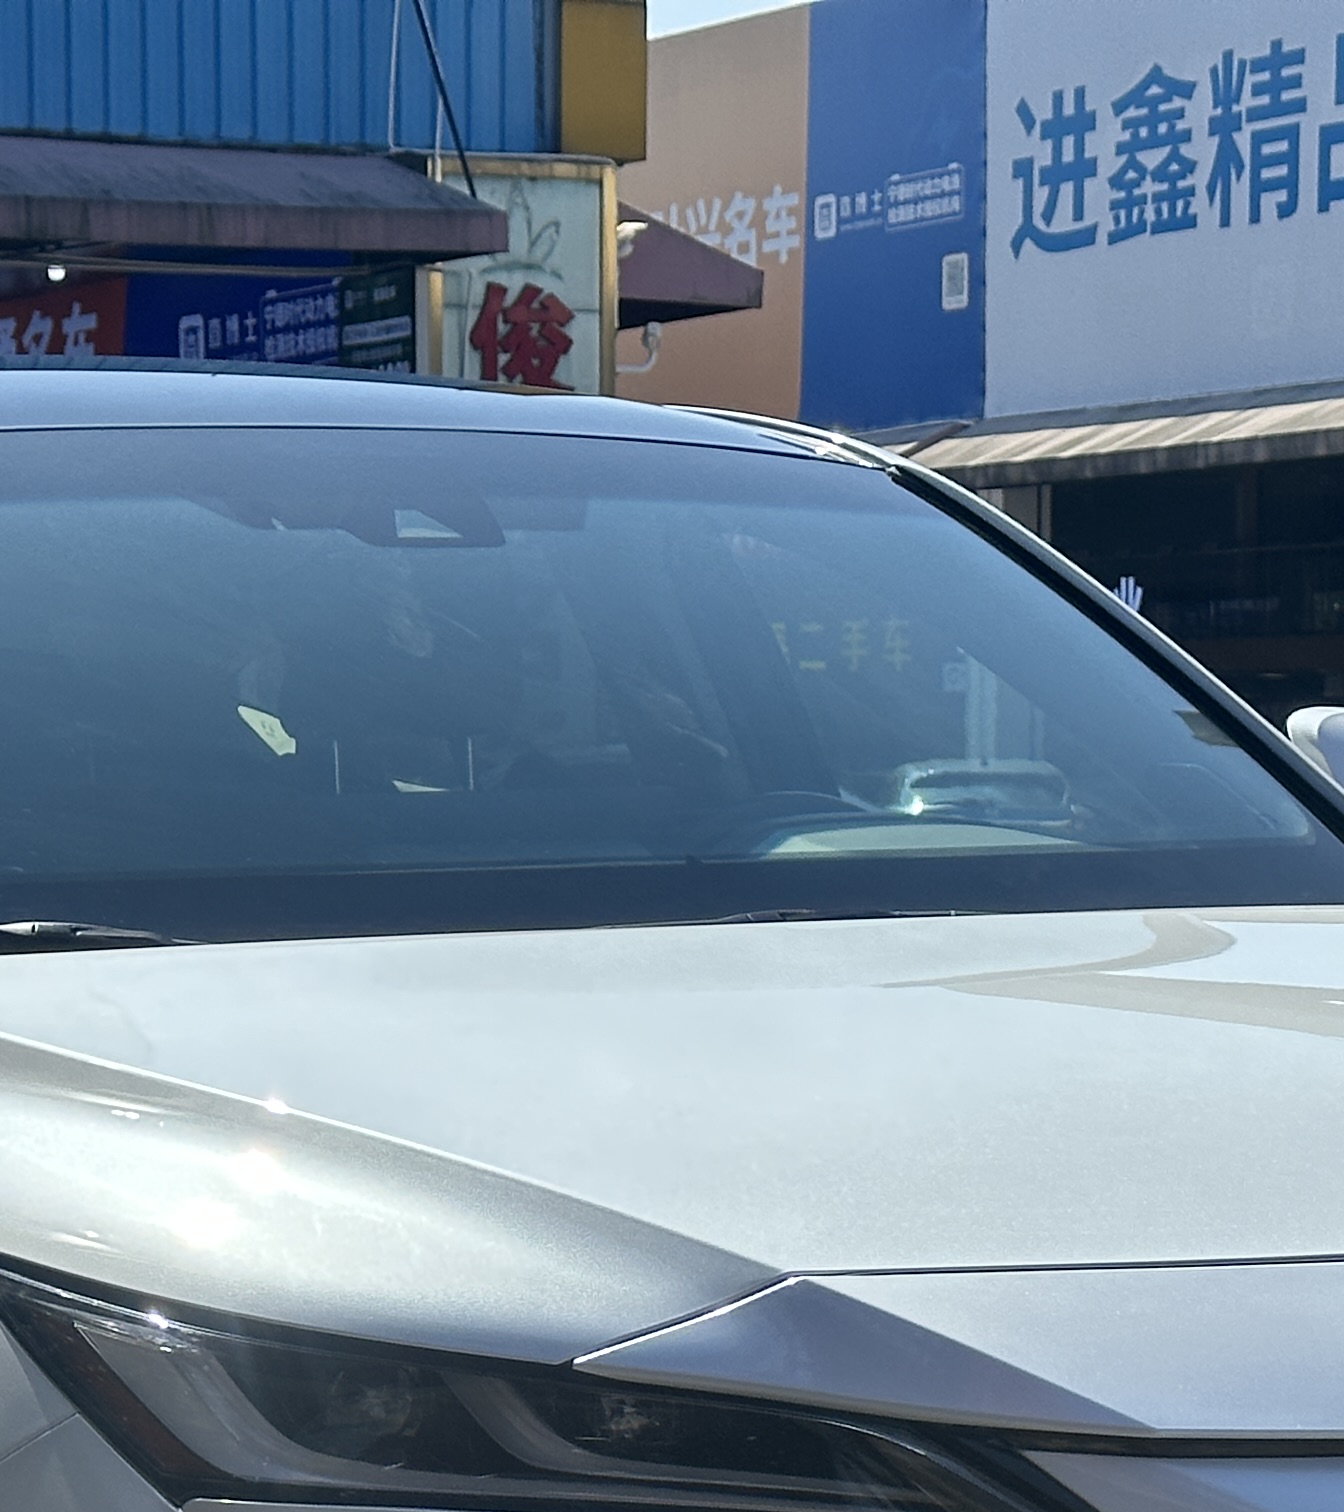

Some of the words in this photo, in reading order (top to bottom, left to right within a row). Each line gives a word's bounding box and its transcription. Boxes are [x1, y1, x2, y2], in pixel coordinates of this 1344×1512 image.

[651, 184, 800, 267] 兴名车
[469, 280, 575, 391] 俊
